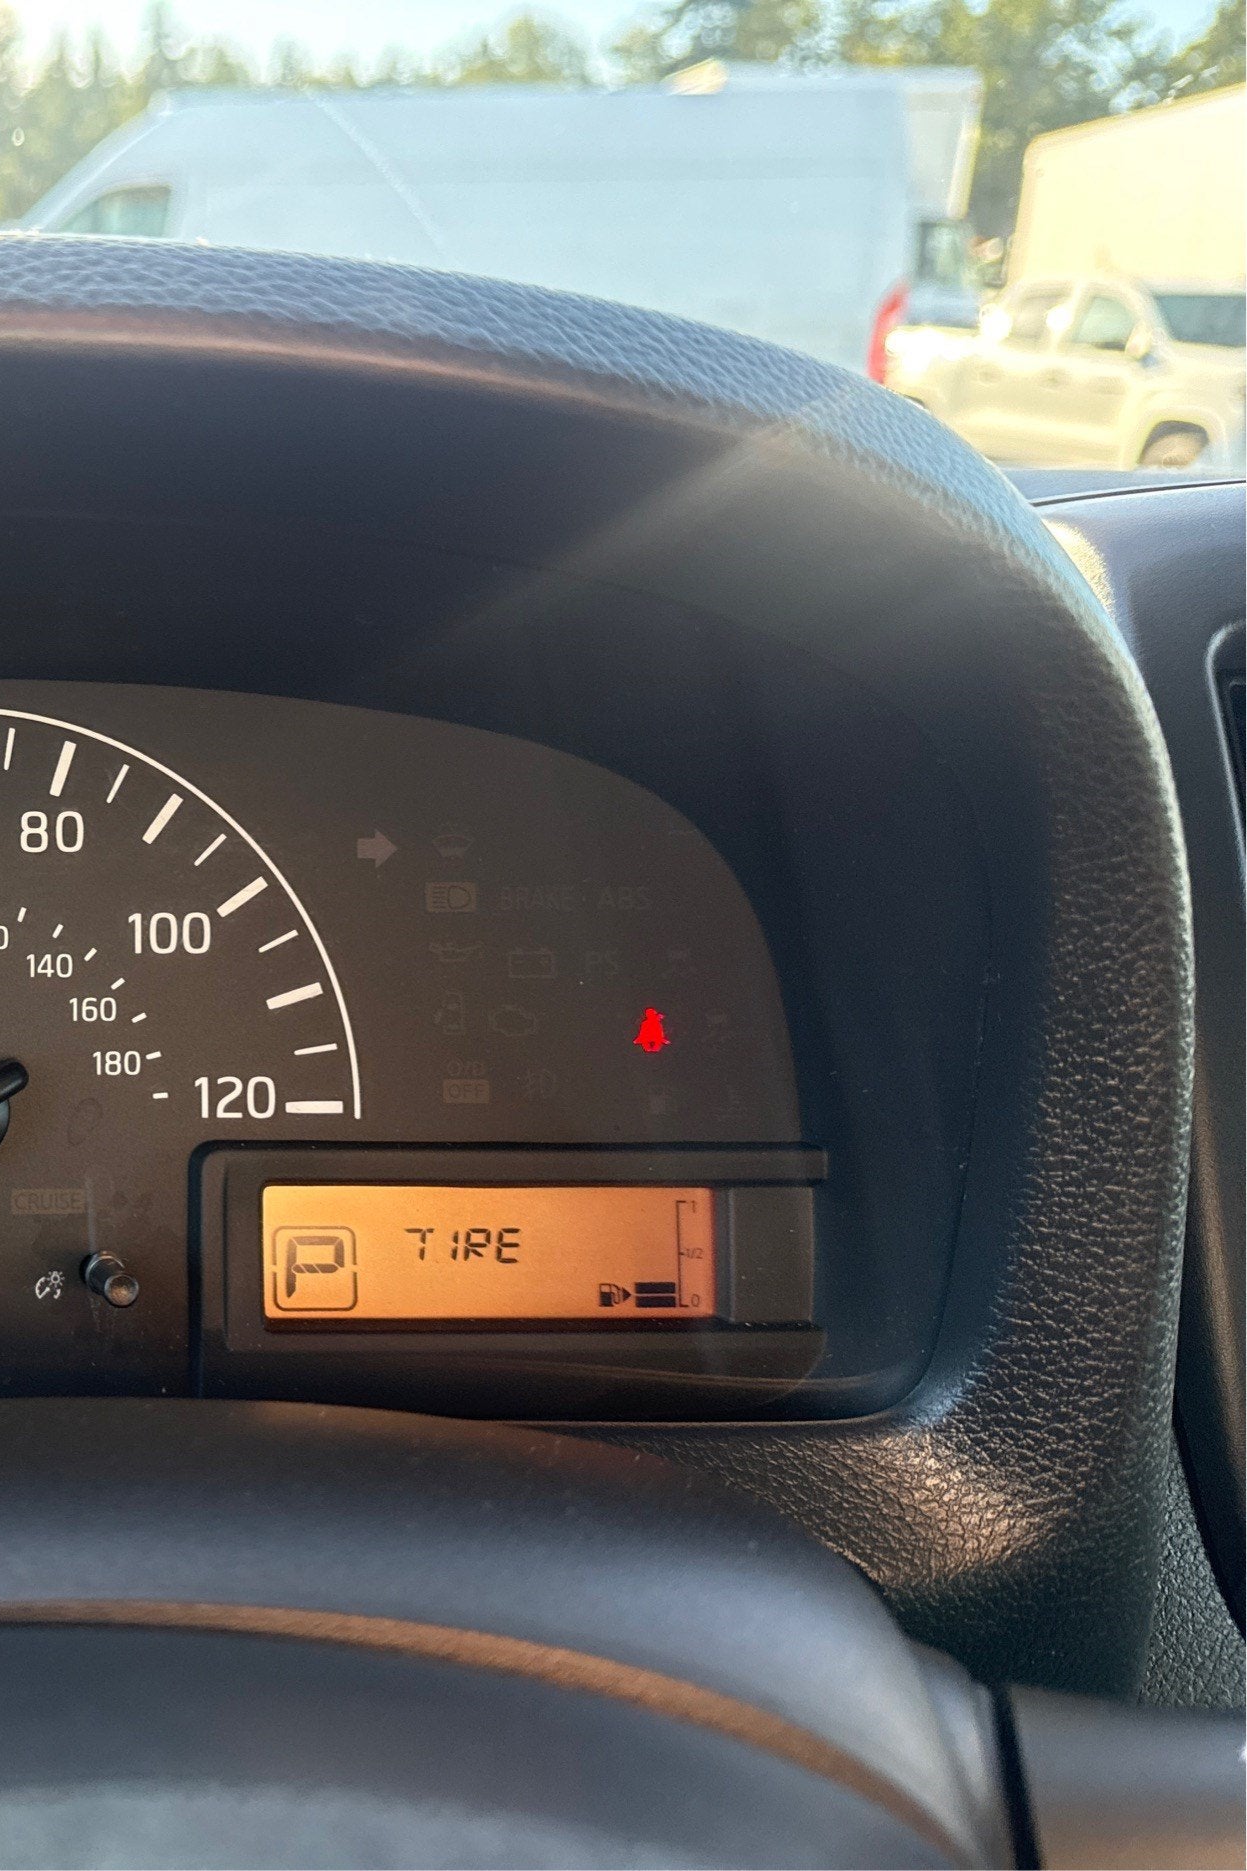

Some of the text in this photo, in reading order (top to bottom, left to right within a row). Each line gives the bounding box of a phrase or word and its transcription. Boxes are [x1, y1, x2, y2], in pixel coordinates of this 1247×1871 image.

[19, 811, 85, 853] 80
[500, 886, 575, 910] BRAKE
[598, 886, 651, 910] ABS
[127, 912, 212, 955] 100
[26, 954, 74, 979] 140
[68, 997, 117, 1023] 160
[92, 1050, 142, 1076] 180
[194, 1076, 277, 1120] 120
[14, 1191, 83, 1211] CRUISE
[404, 1227, 521, 1264] TIRE
[285, 1235, 346, 1300] P
